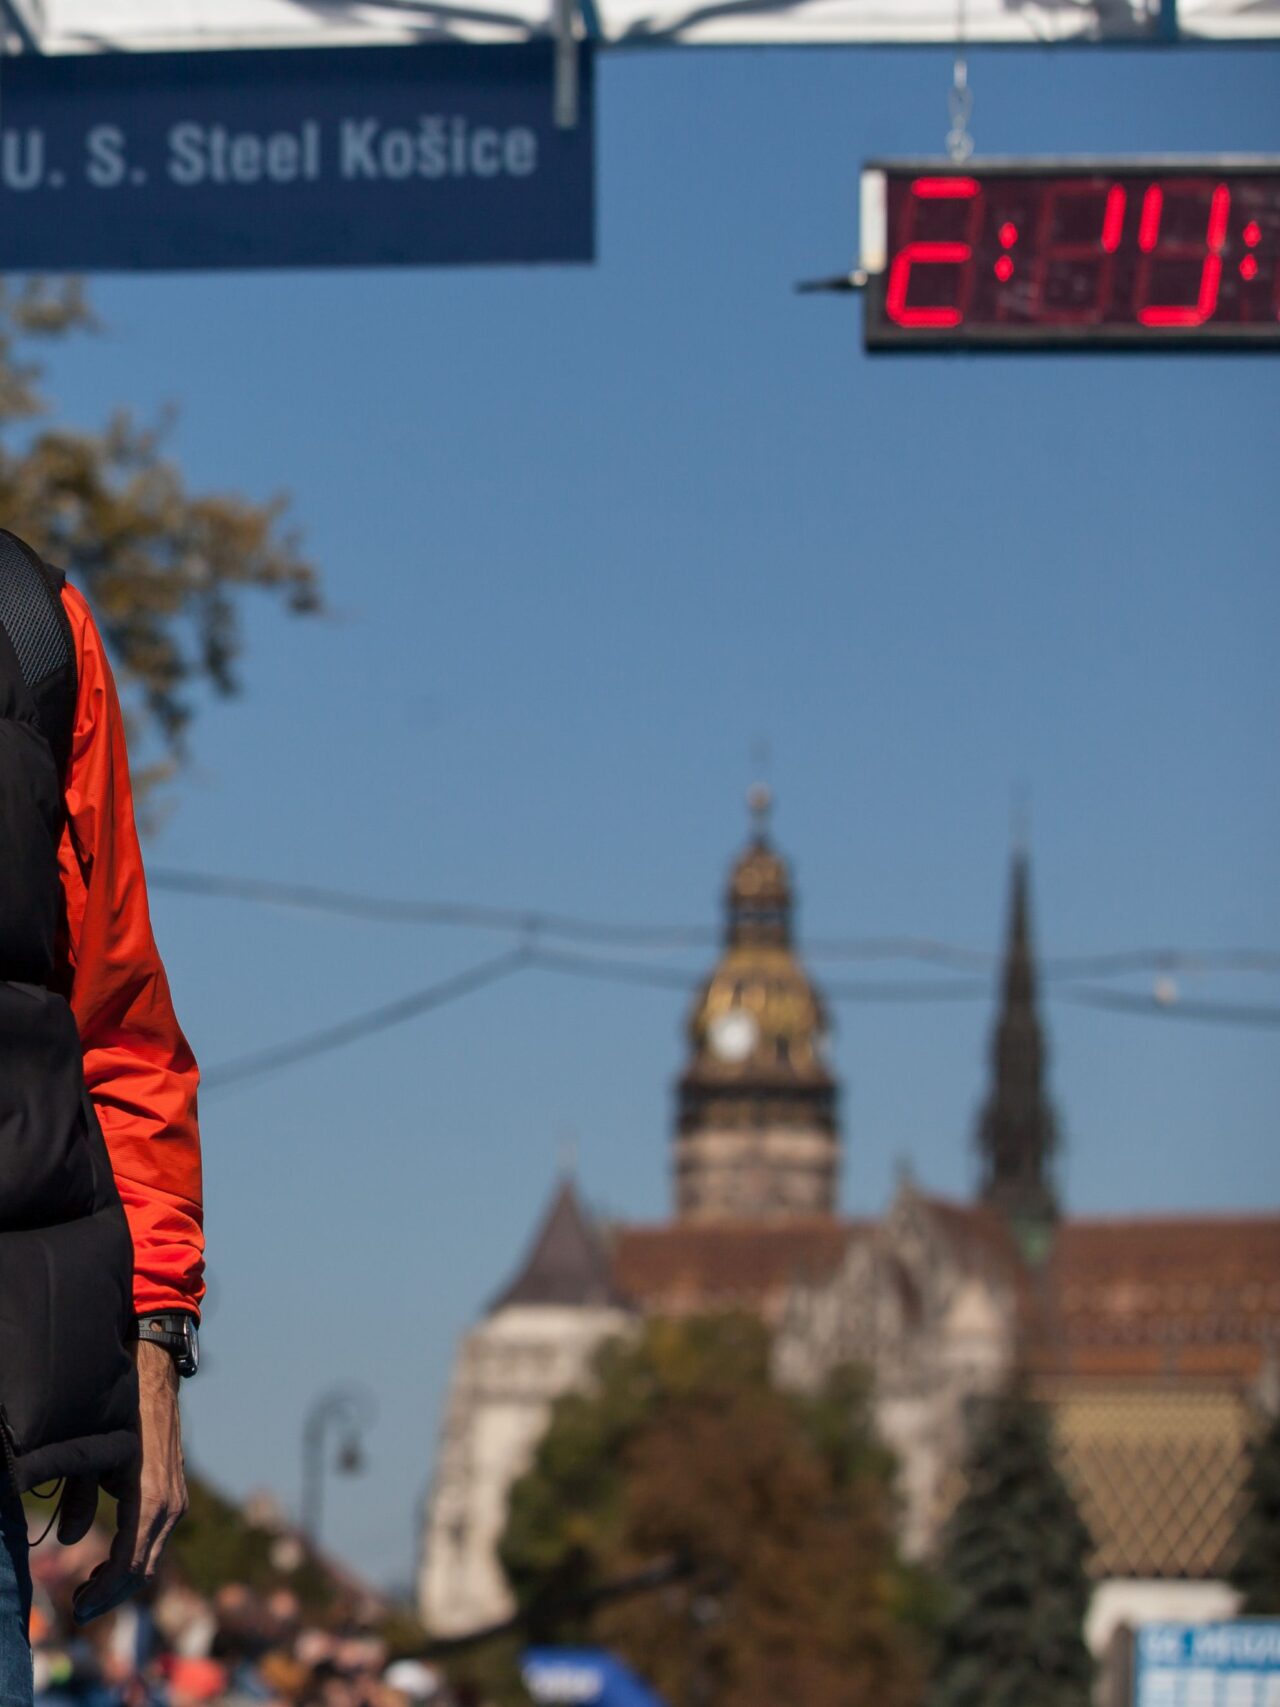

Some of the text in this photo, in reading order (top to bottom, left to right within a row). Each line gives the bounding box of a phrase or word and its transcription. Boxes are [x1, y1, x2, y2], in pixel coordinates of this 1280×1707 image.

[1, 113, 539, 190] U. S. Steel Košice
